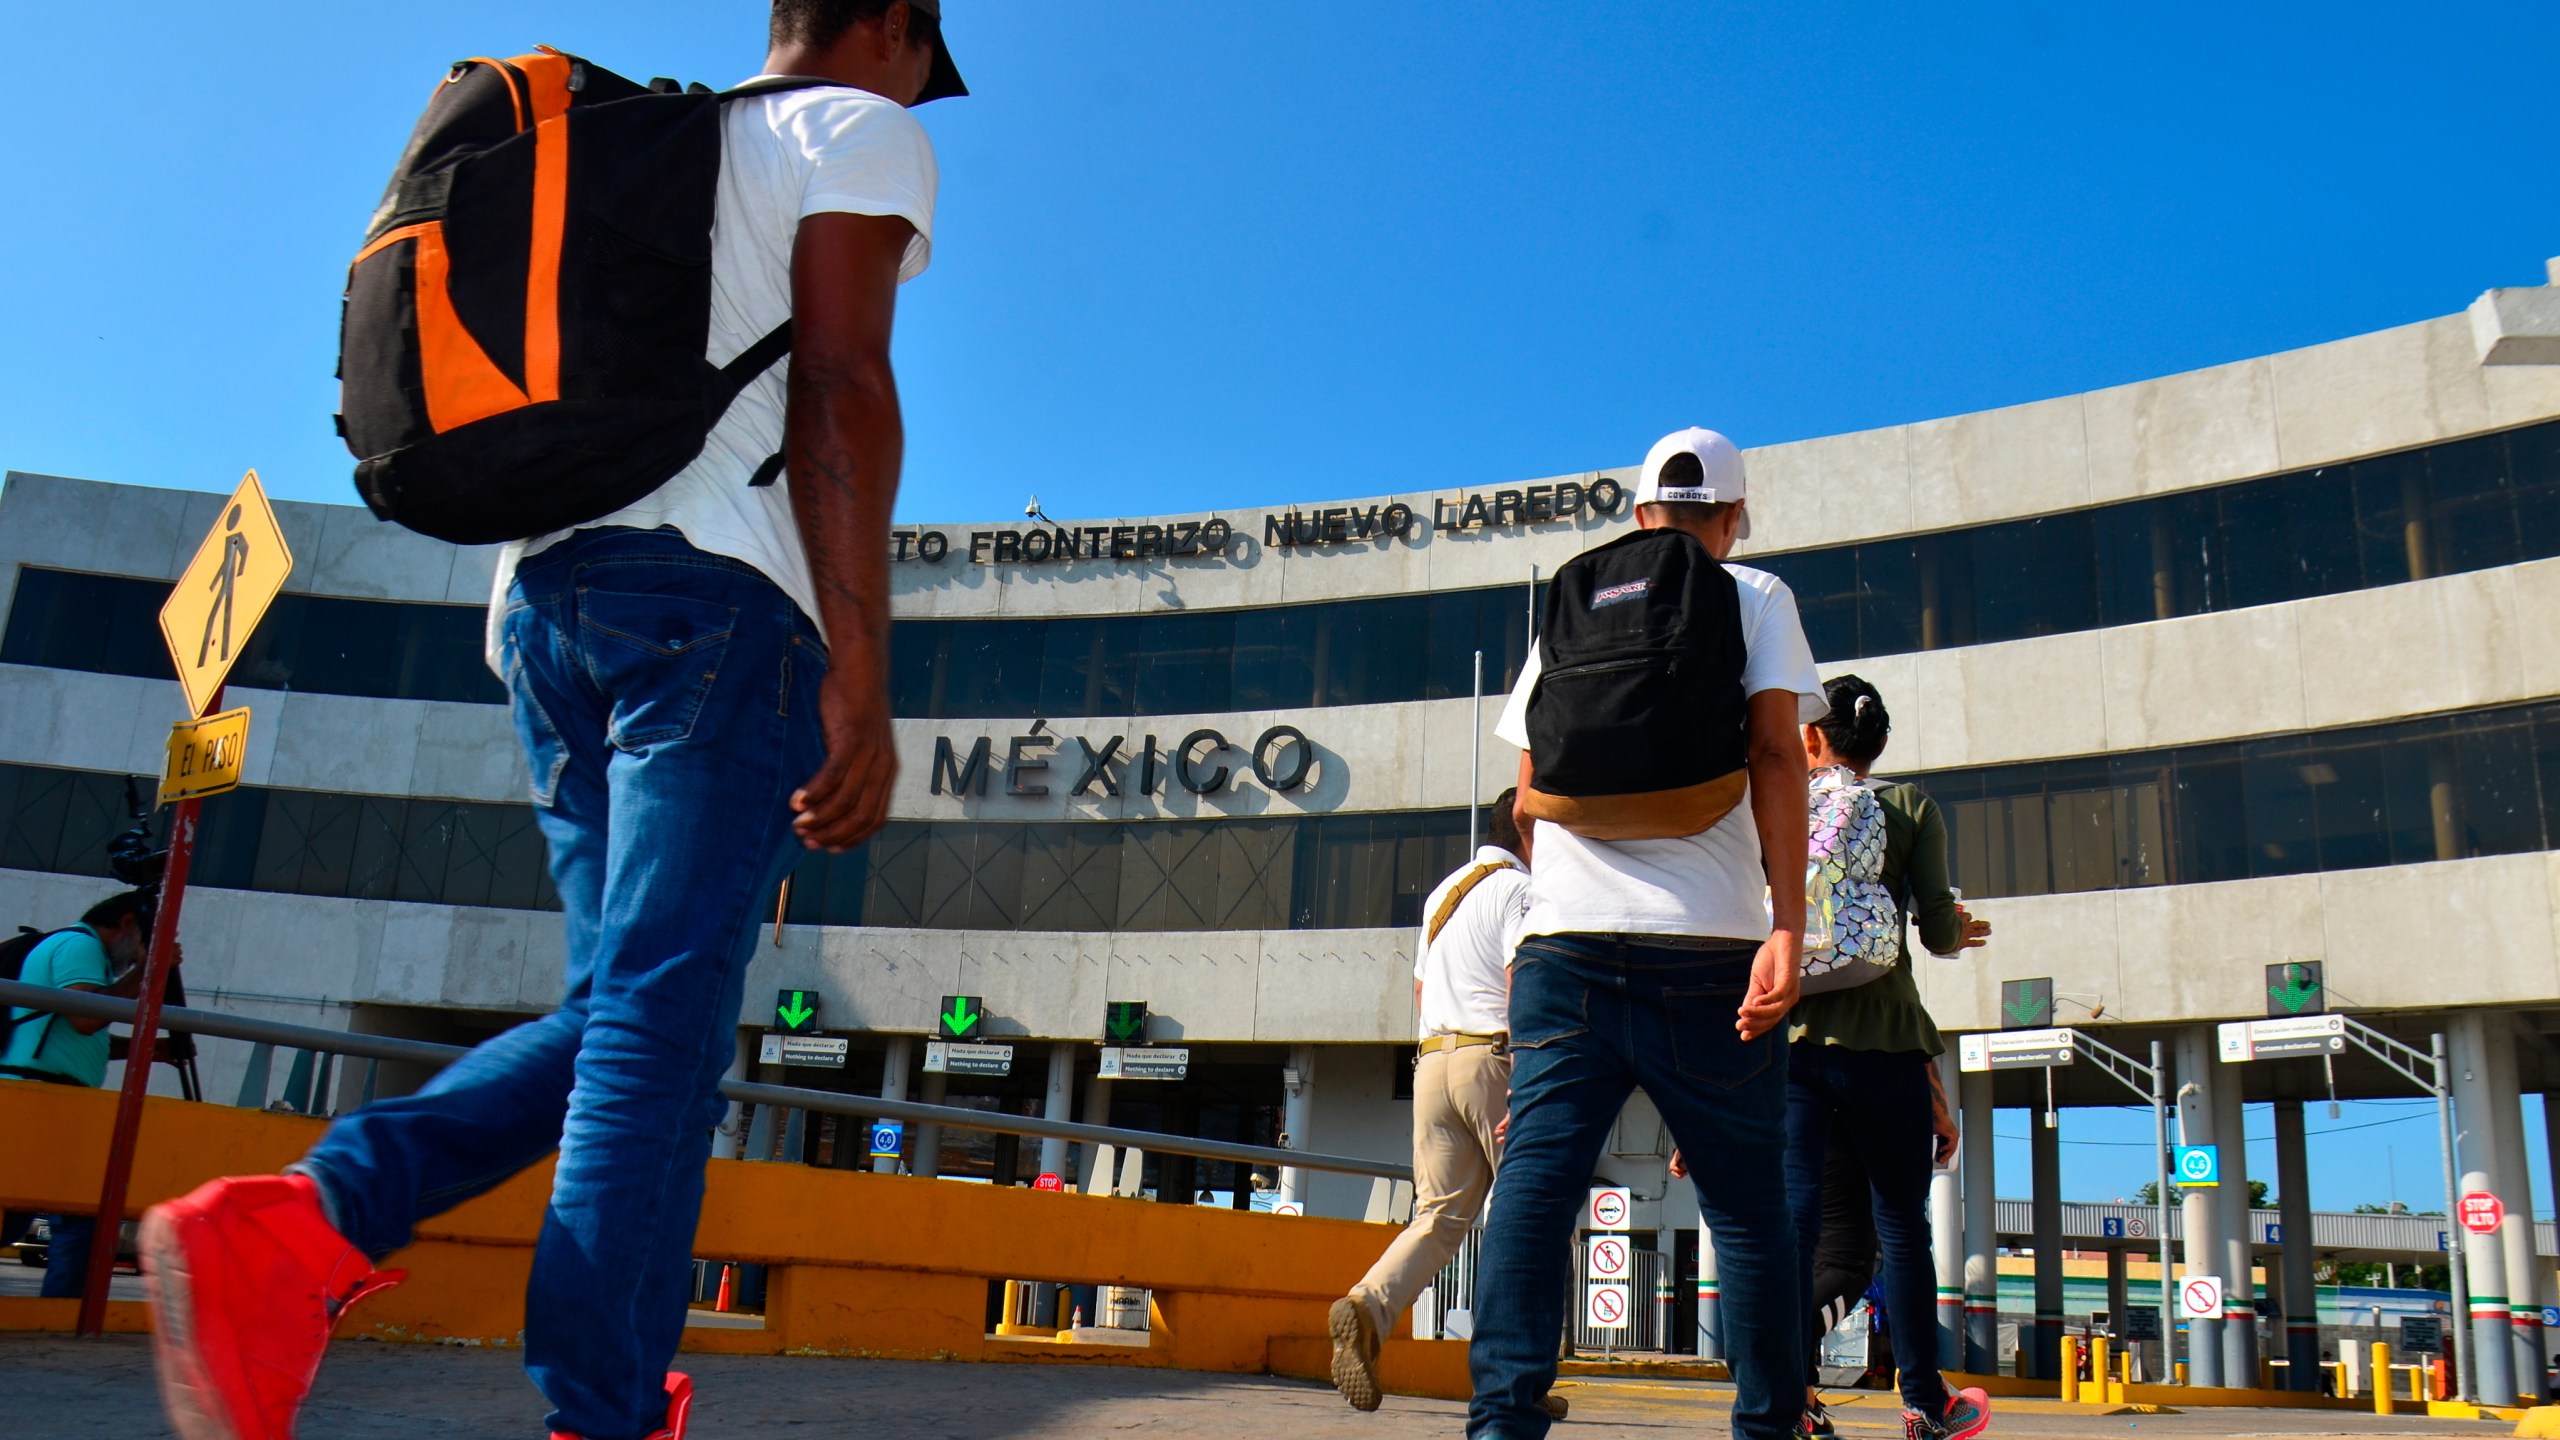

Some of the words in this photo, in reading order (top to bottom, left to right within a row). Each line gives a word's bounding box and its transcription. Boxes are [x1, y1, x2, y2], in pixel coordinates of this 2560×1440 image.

[1668, 491, 1707, 500] COWBOYS
[969, 518, 1232, 563] FRONTERIZO
[1264, 503, 1414, 547] NUEVO
[1433, 478, 1622, 531] LAREDO
[181, 743, 196, 777] EL
[202, 732, 238, 773] PASO
[930, 719, 1312, 796] MÉXICO
[785, 1053, 807, 1061] Nothing
[950, 1060, 971, 1068] Nothing
[1125, 1065, 1147, 1073] Nothing
[1040, 1177, 1058, 1188] STOP
[2465, 1198, 2494, 1212] STOP
[2467, 1212, 2497, 1226] ALTO
[2107, 1219, 2118, 1236] 3
[2270, 1226, 2280, 1242] 4
